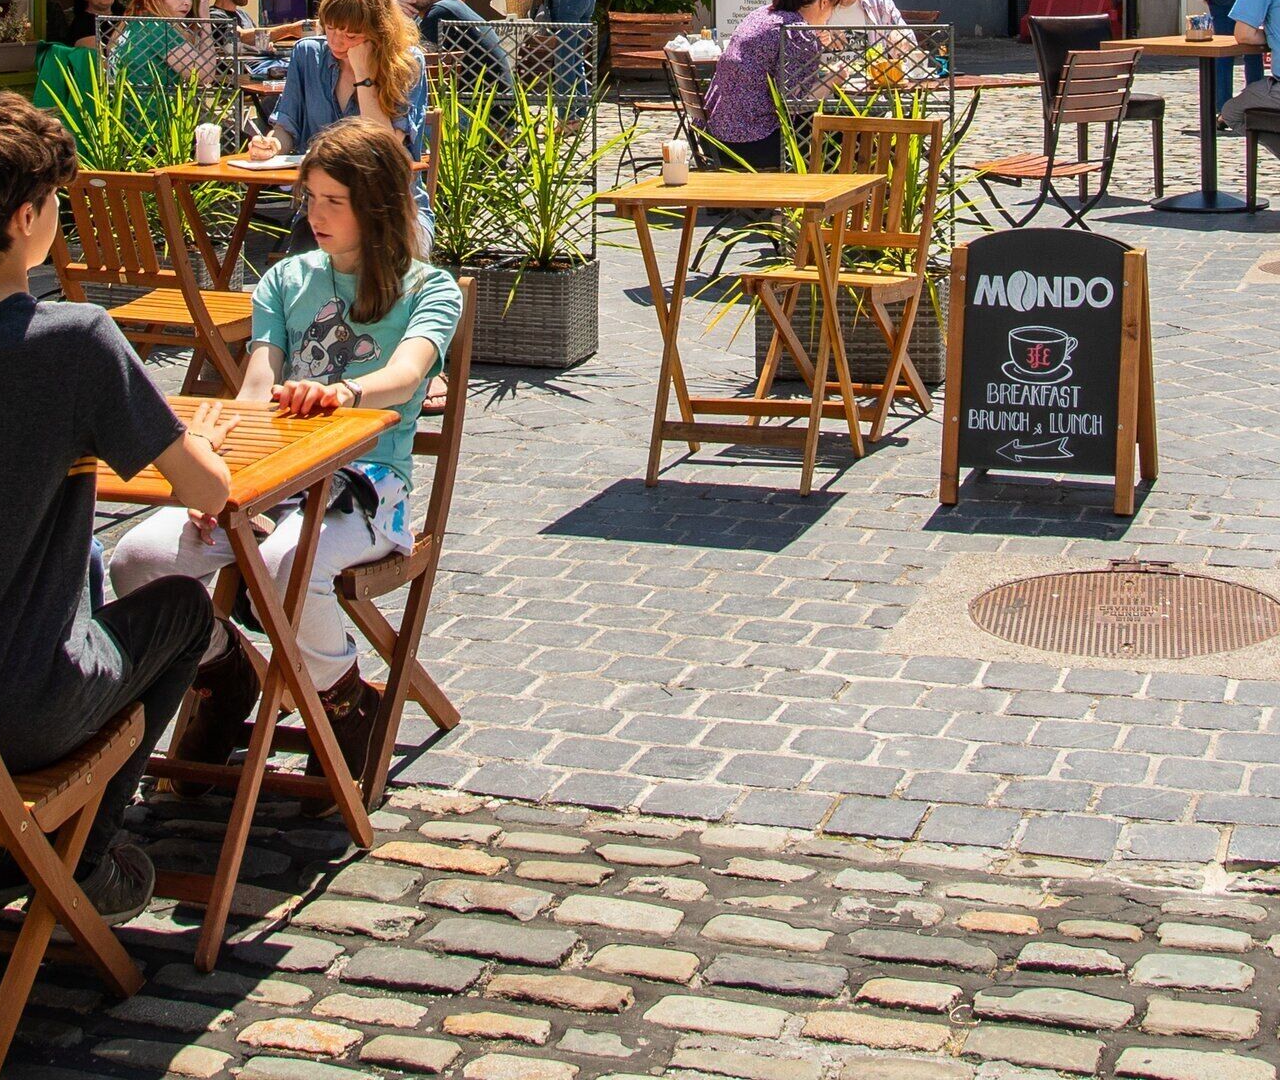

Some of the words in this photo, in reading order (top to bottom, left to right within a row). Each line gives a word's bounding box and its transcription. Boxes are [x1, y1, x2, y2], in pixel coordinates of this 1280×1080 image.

[973, 270, 1114, 312] MONDO
[986, 383, 1081, 408] BREAKFAST
[968, 408, 1030, 432] BRUNCH
[1049, 412, 1103, 435] LUNCH
